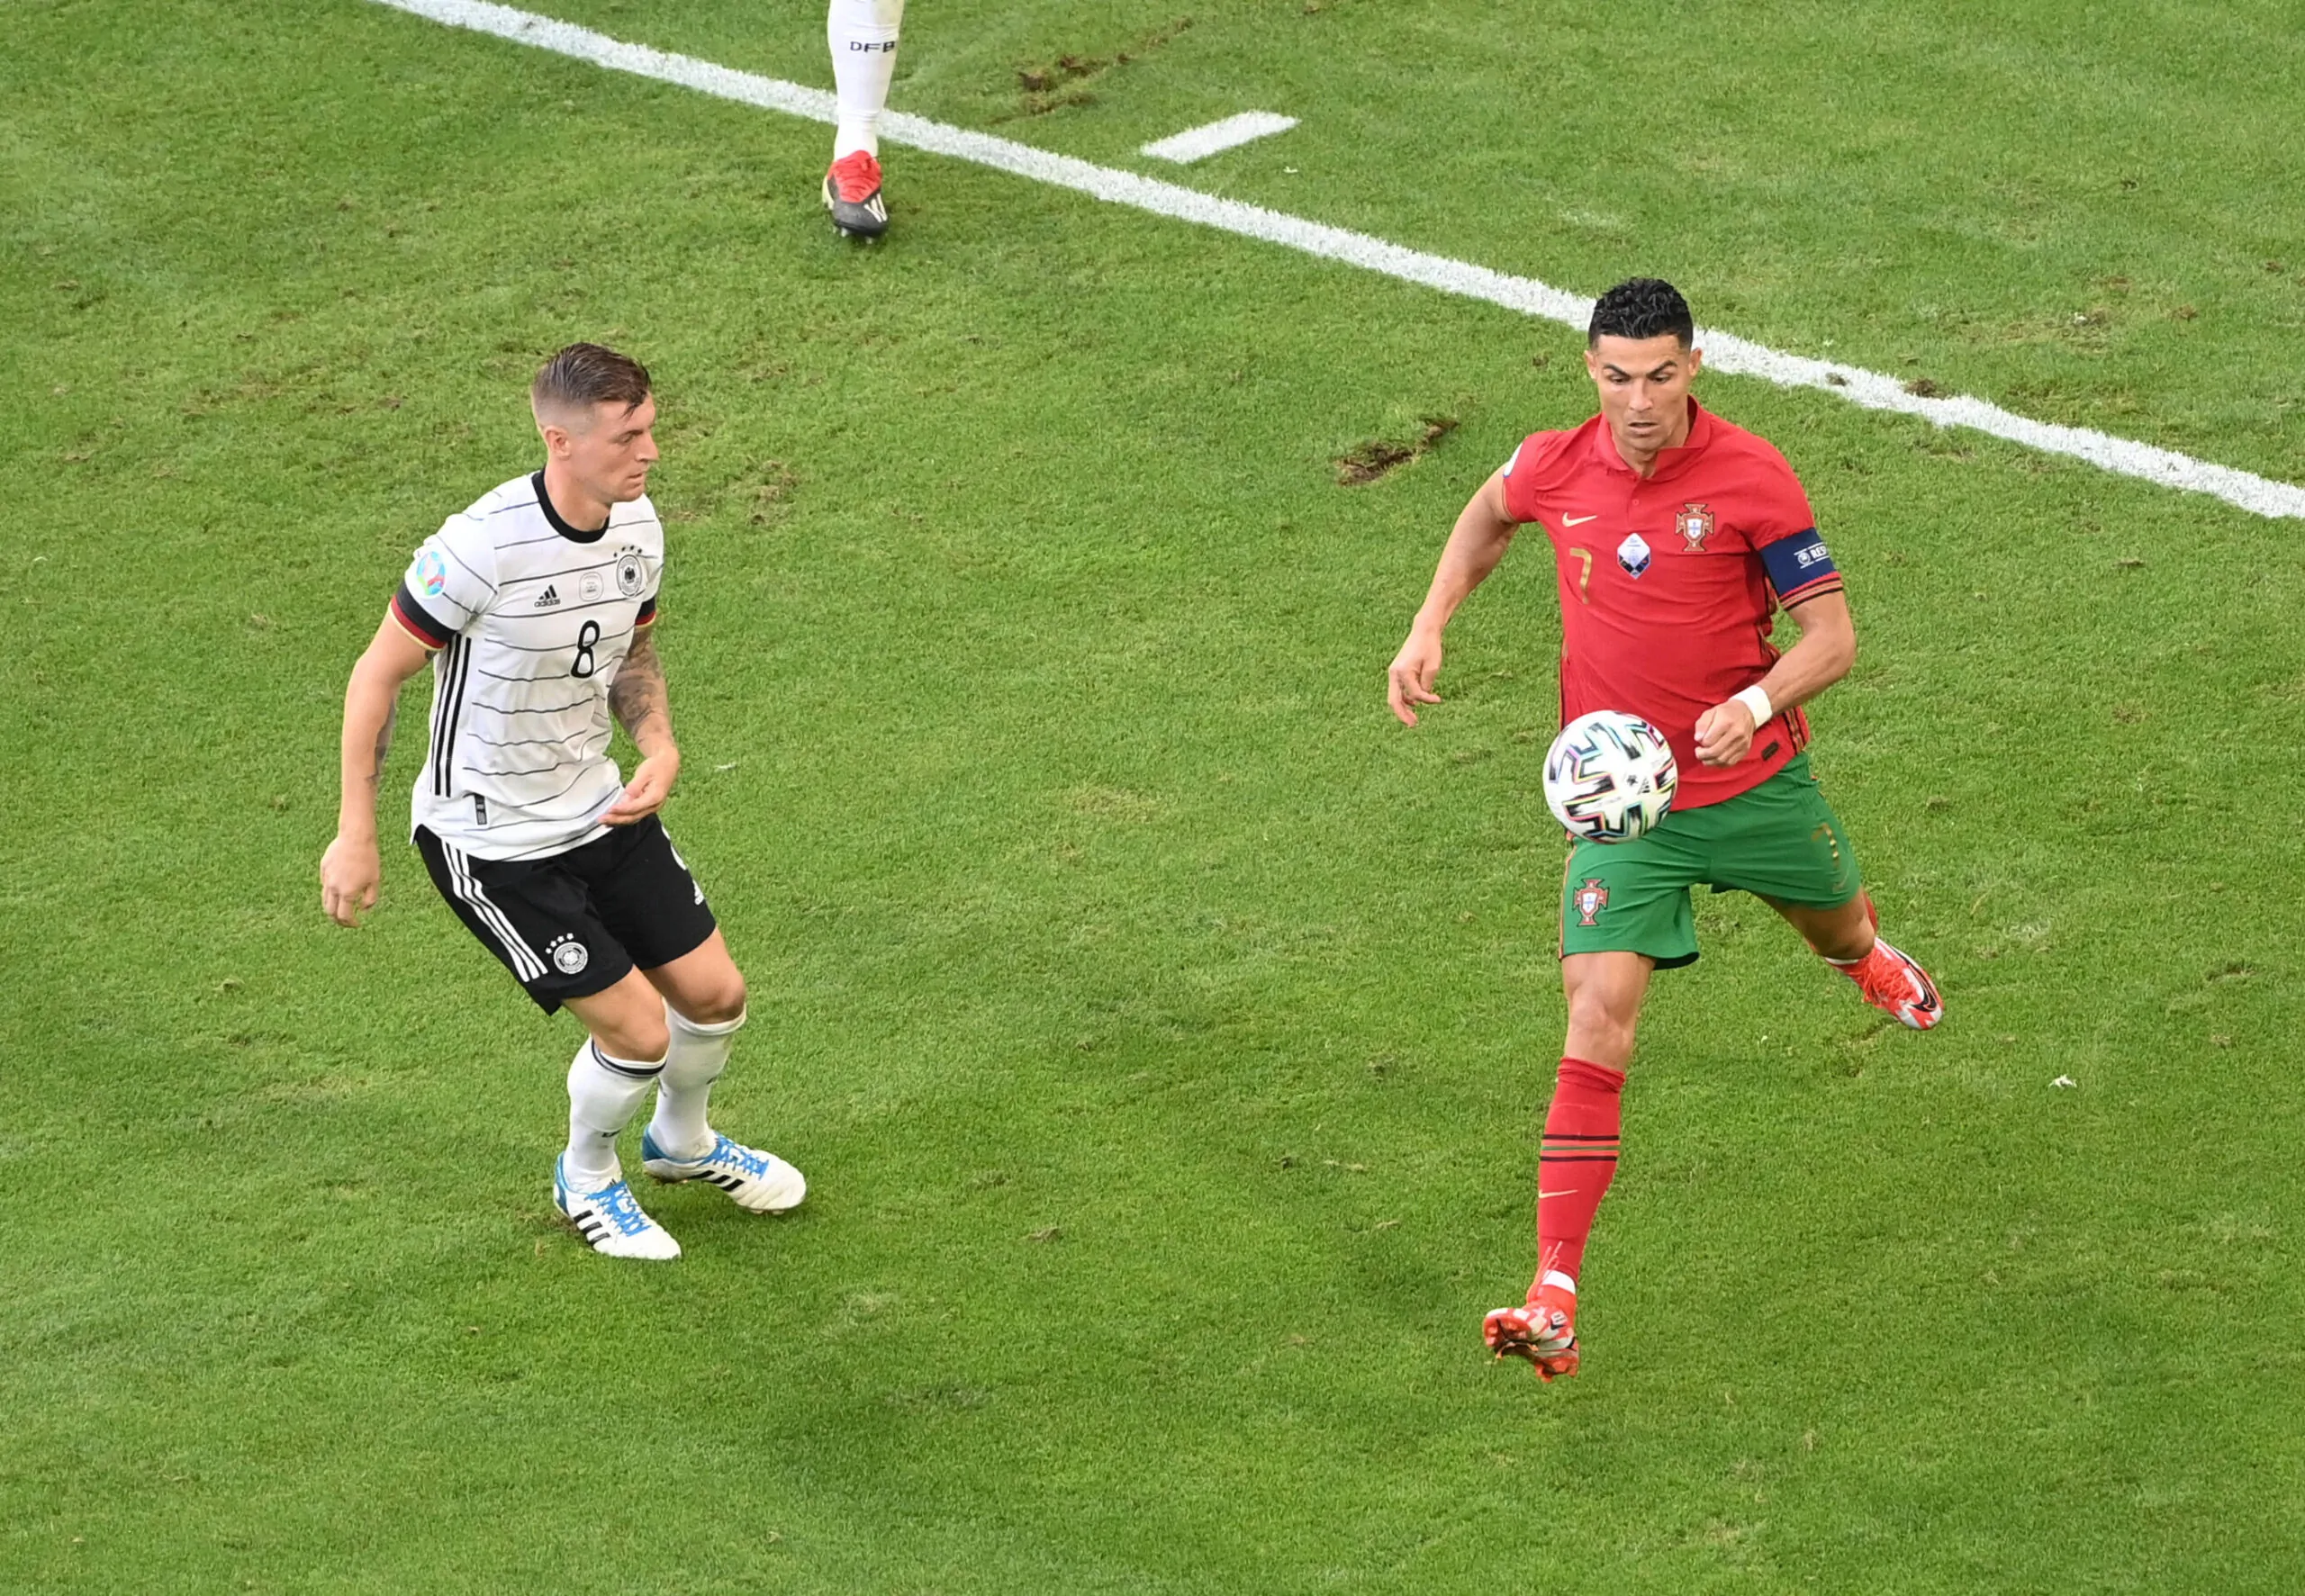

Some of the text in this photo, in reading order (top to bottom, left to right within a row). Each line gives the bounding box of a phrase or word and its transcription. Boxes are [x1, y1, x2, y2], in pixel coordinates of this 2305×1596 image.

[850, 41, 896, 53] DFB
[1569, 547, 1592, 605] 7
[571, 619, 601, 678] 8
